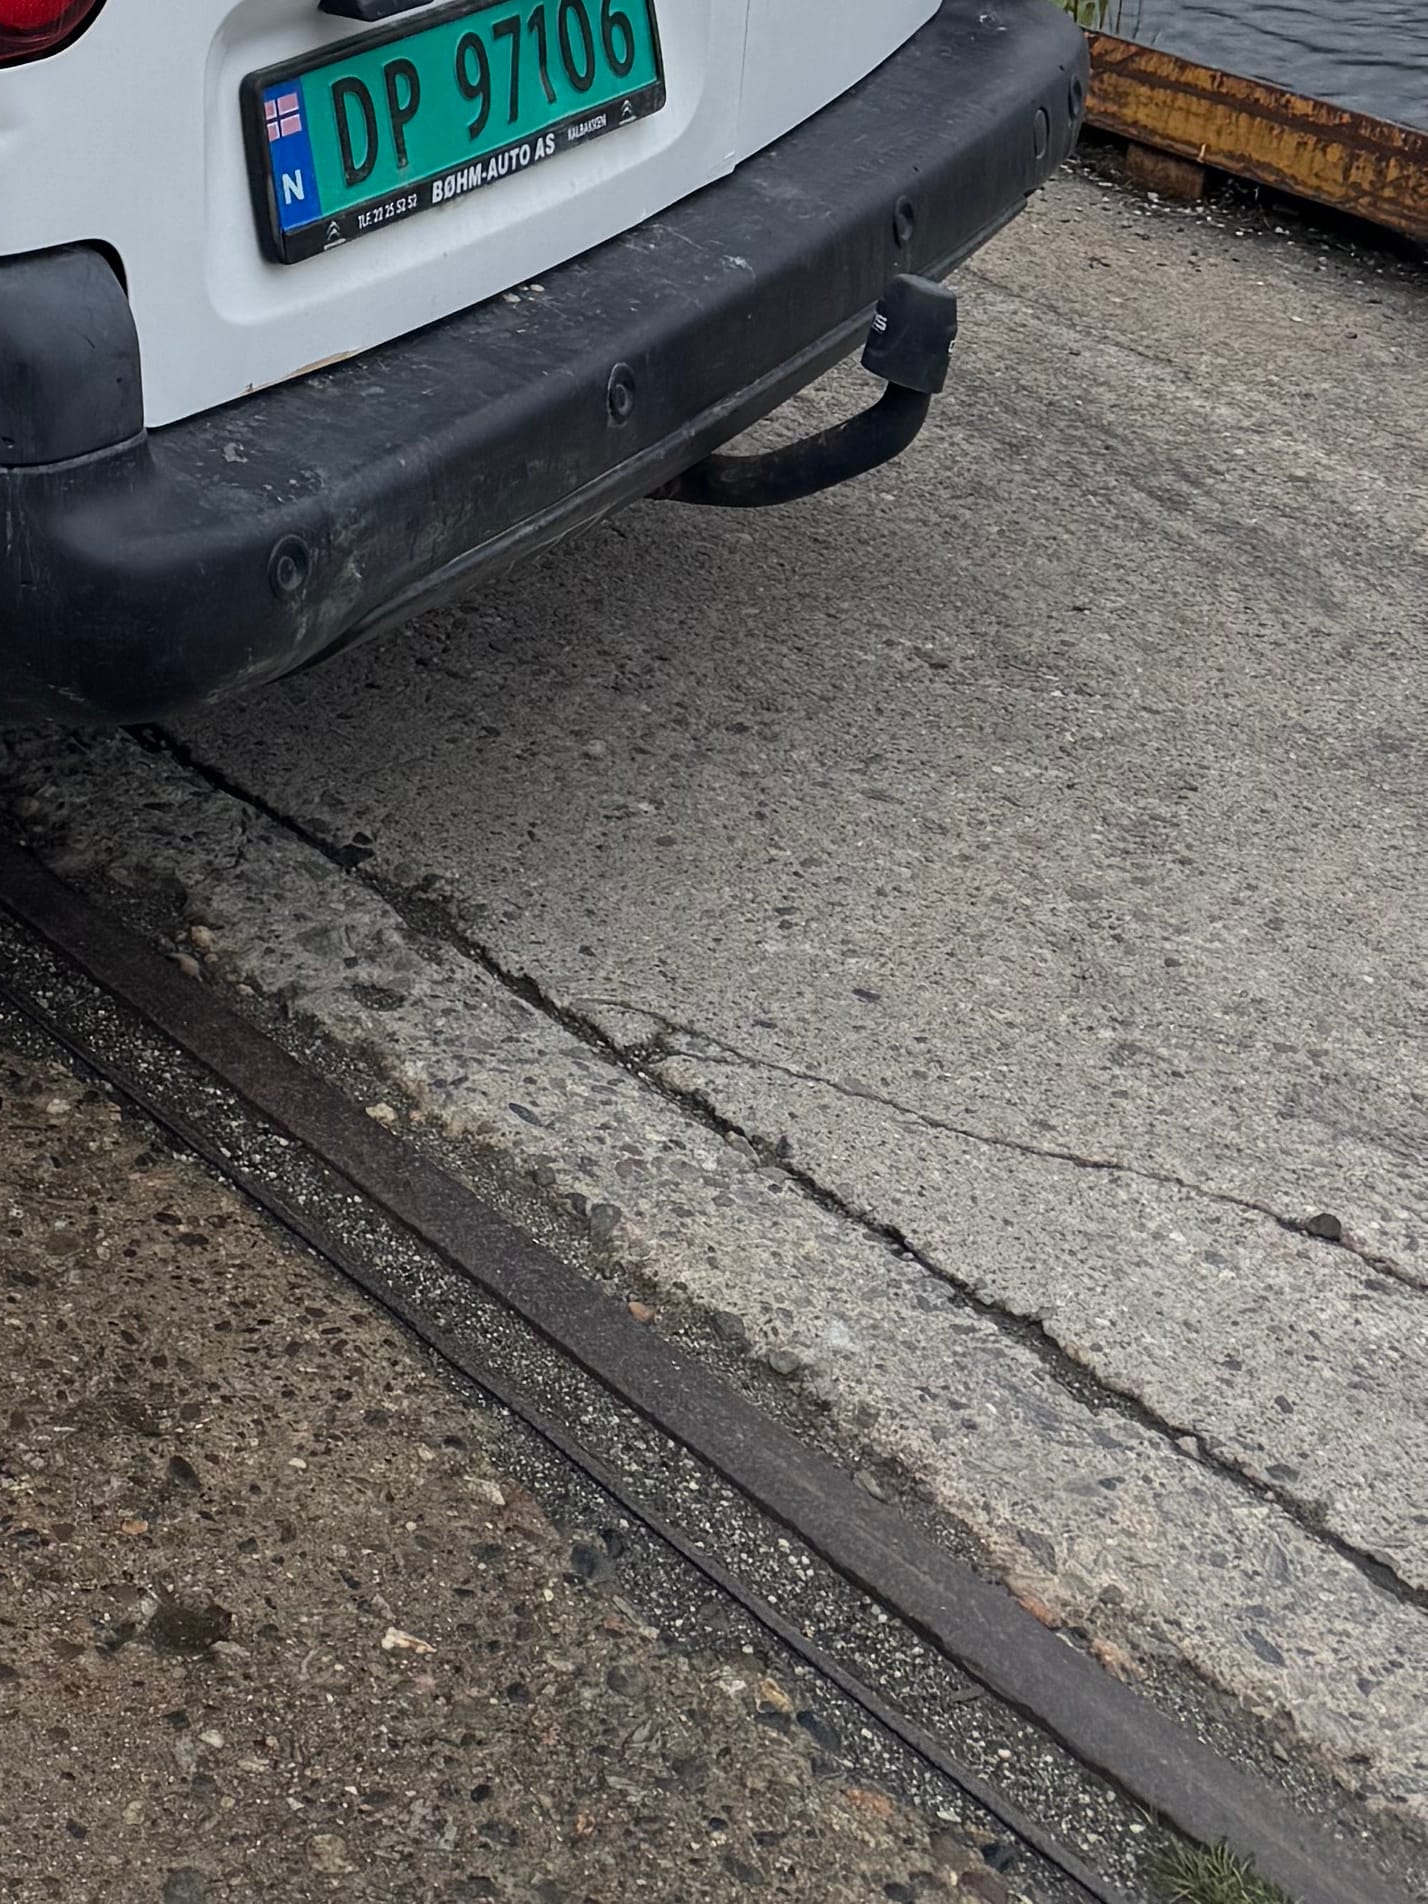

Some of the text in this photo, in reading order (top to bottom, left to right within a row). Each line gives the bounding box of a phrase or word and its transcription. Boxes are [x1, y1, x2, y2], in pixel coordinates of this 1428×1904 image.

[329, 57, 421, 187] DP
[282, 168, 305, 205] N
[431, 143, 531, 204] BØHM-AUTO
[534, 132, 556, 162] AS
